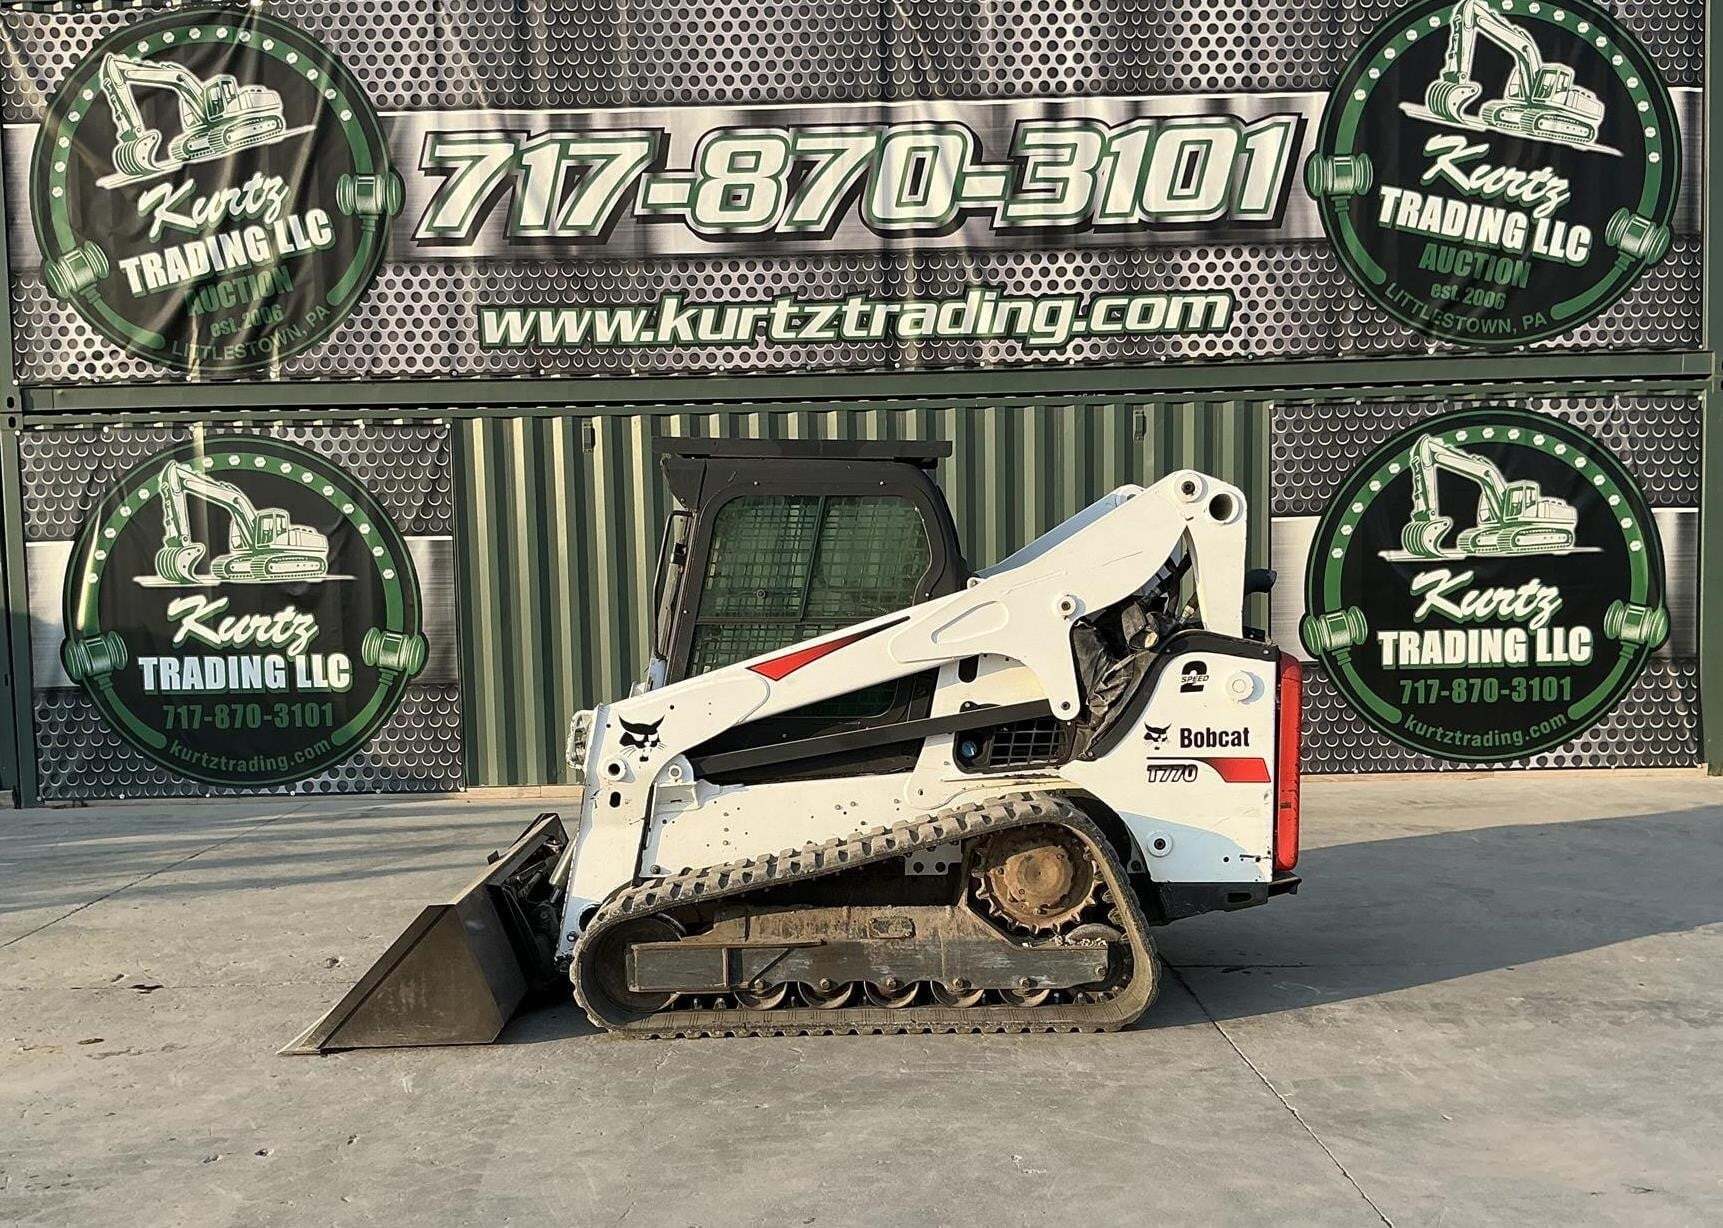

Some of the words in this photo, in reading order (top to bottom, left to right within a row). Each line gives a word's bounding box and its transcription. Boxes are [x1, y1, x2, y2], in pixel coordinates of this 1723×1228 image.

[414, 114, 1304, 245] 717-870-3101
[1421, 134, 1571, 218] Kurtz
[138, 172, 290, 242] Kurtz
[1379, 185, 1528, 253] TRADING
[1533, 218, 1593, 267] LLC
[119, 226, 274, 297] TRADING
[275, 209, 336, 258] LLC
[1418, 244, 1532, 288] AUCTION
[187, 265, 294, 315] AUCTION
[1384, 282, 1517, 335] LITTLESTOWN,
[1523, 312, 1548, 328] PA
[1462, 286, 1506, 310] 2006
[242, 304, 285, 331] 2006
[307, 306, 331, 330] PA
[479, 288, 1236, 348] www.kurtztrading.com
[1410, 569, 1562, 629] Kurtz
[167, 595, 319, 656] Kurtz
[1377, 628, 1529, 669] TRADING
[1534, 626, 1593, 667] LLC
[138, 655, 288, 694] TRADING
[295, 653, 353, 693] LLC
[1181, 674, 1209, 683] SPEED
[1400, 677, 1571, 704] 717-870-3101
[164, 702, 334, 730] 717-870-3101
[1180, 727, 1249, 748] Bobcat
[1405, 715, 1567, 747] kurtztrading.com
[169, 738, 331, 773] kurtztrading.com
[1147, 764, 1198, 782] T770
